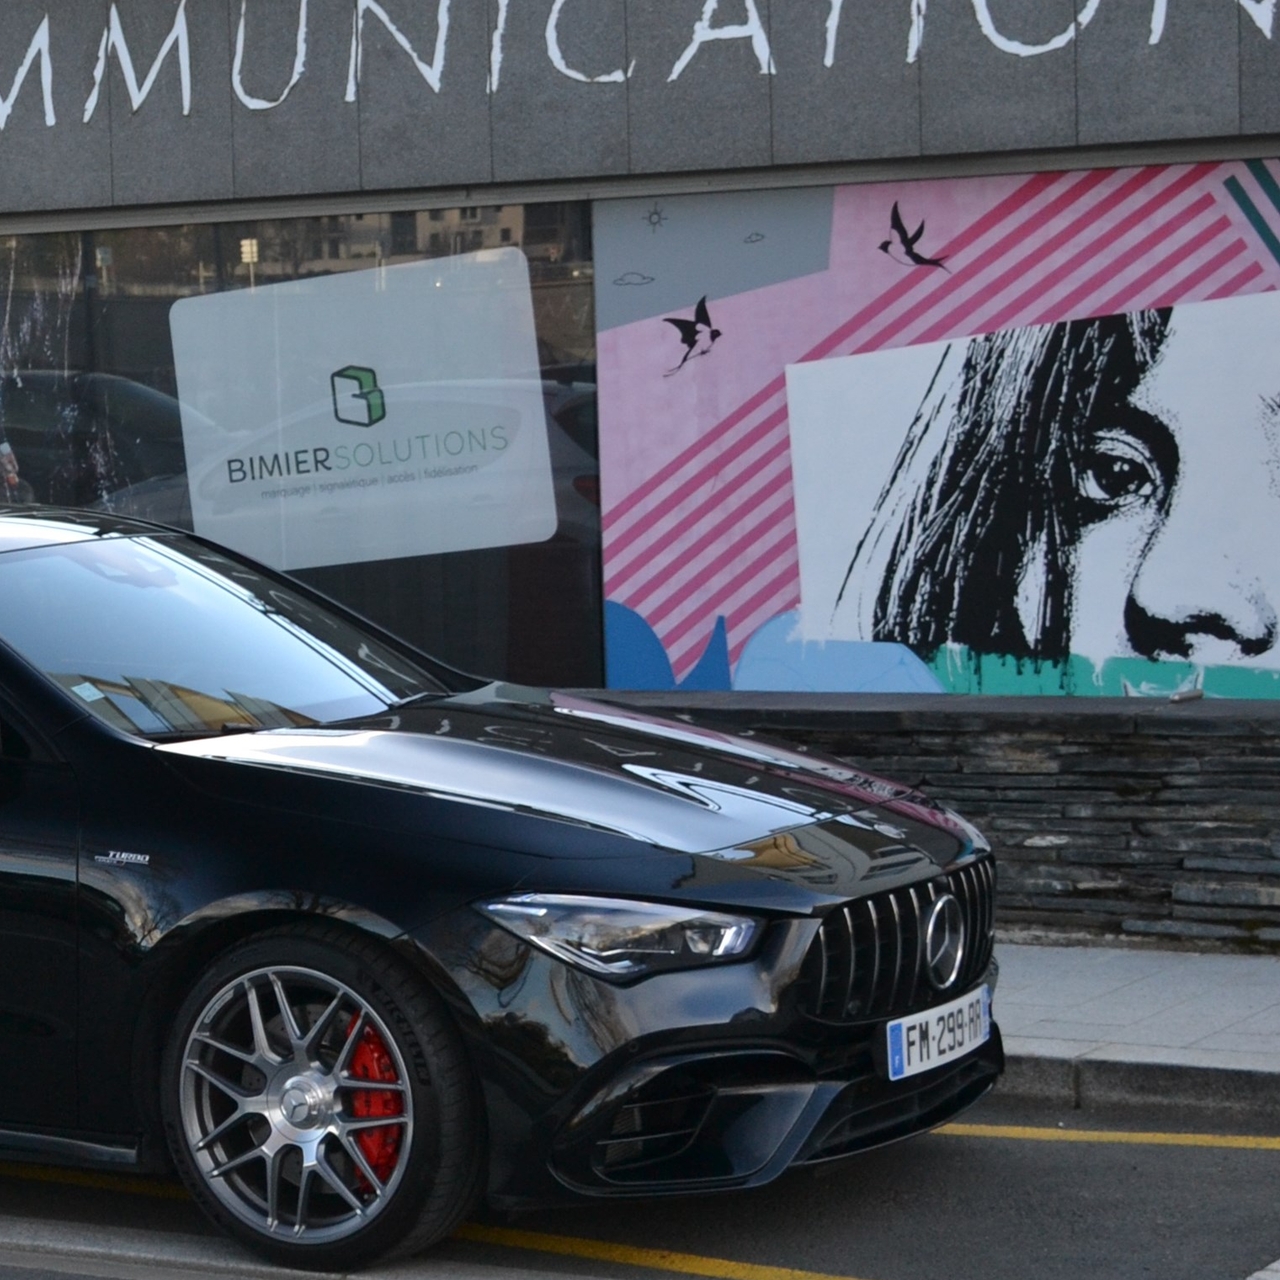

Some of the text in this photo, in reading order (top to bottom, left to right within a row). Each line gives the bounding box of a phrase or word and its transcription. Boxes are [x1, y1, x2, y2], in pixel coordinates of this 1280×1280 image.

[261, 484, 311, 499] marquage
[387, 471, 416, 483] accès
[423, 463, 478, 479] fidélisation
[108, 850, 150, 863] TURBO
